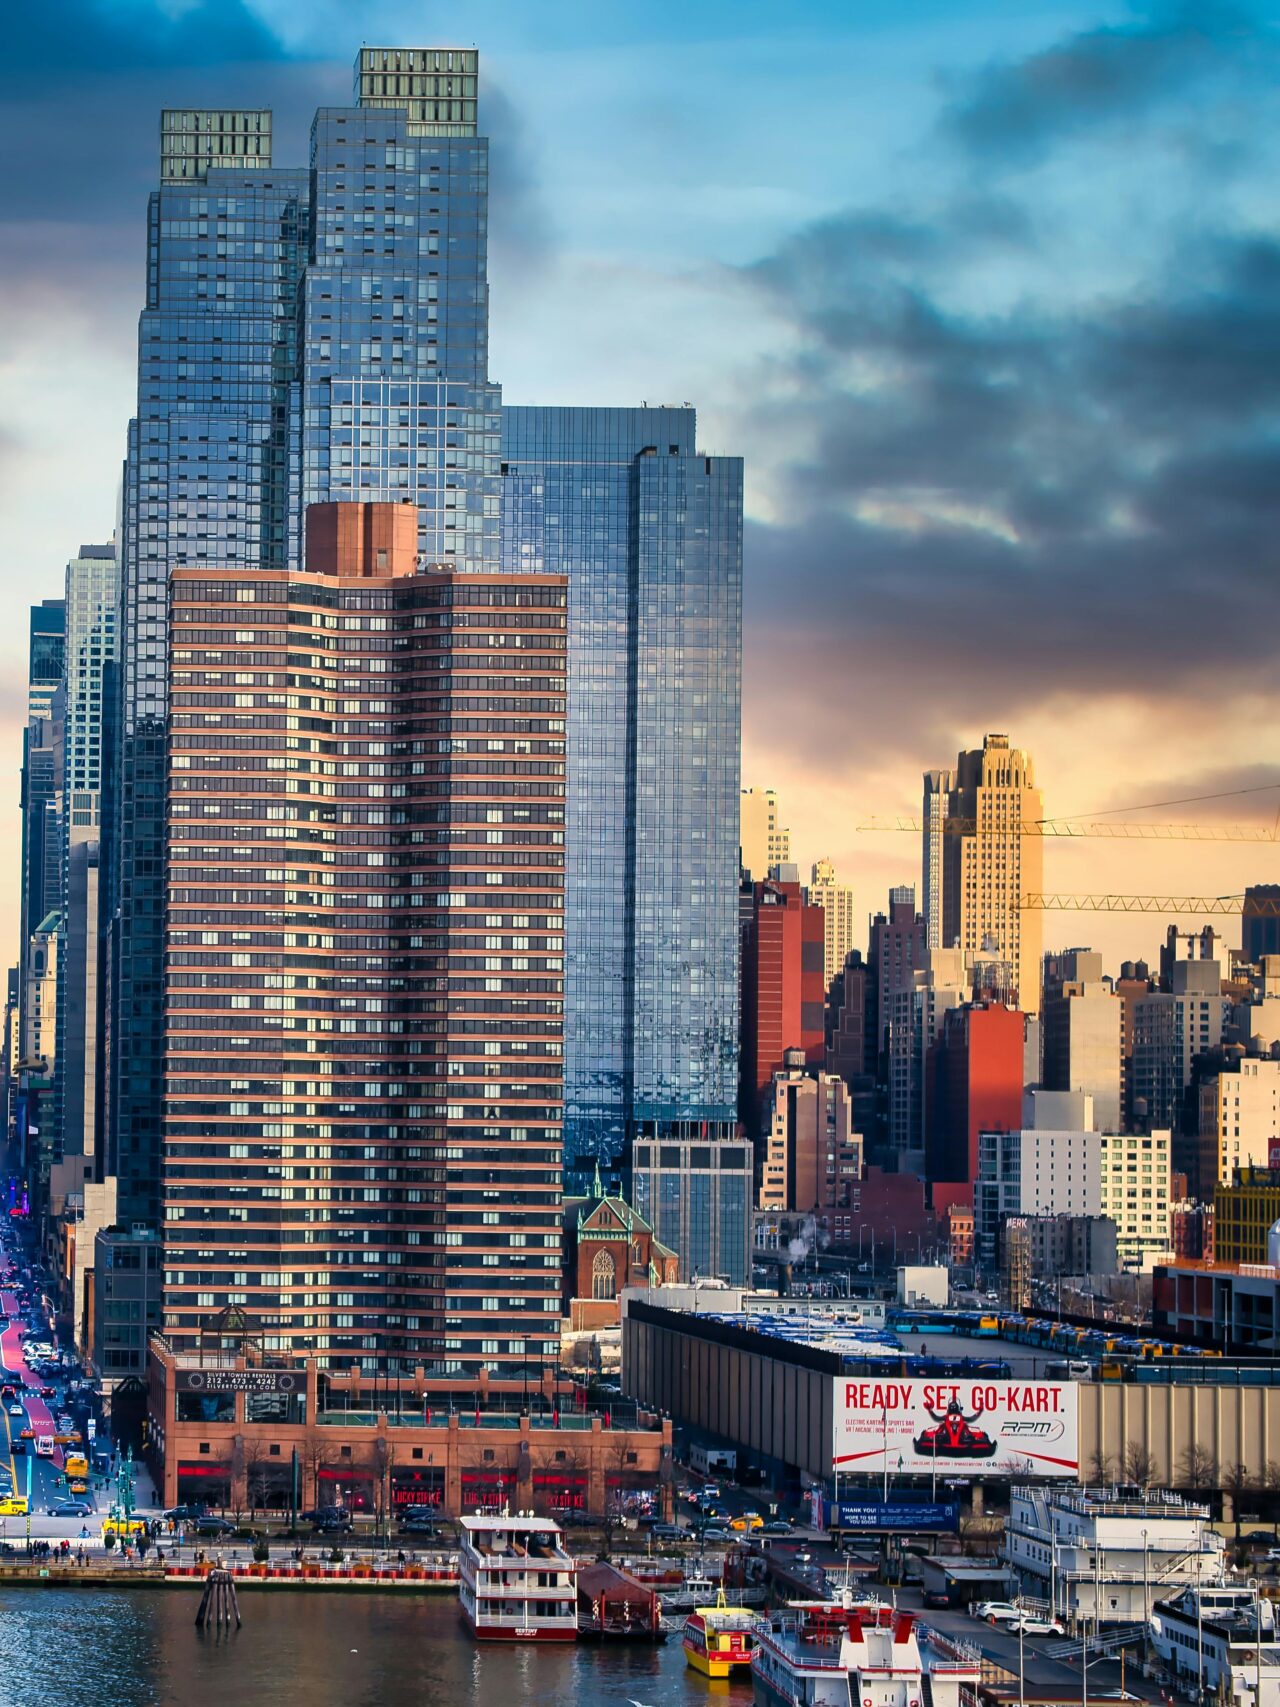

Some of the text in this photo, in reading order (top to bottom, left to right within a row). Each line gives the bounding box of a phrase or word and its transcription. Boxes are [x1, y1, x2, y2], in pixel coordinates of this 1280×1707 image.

[845, 1384, 1065, 1412] READY. SET GO-KART.
[1001, 1421, 1051, 1433] RPM
[392, 1490, 441, 1504] LUCKY STRIKE
